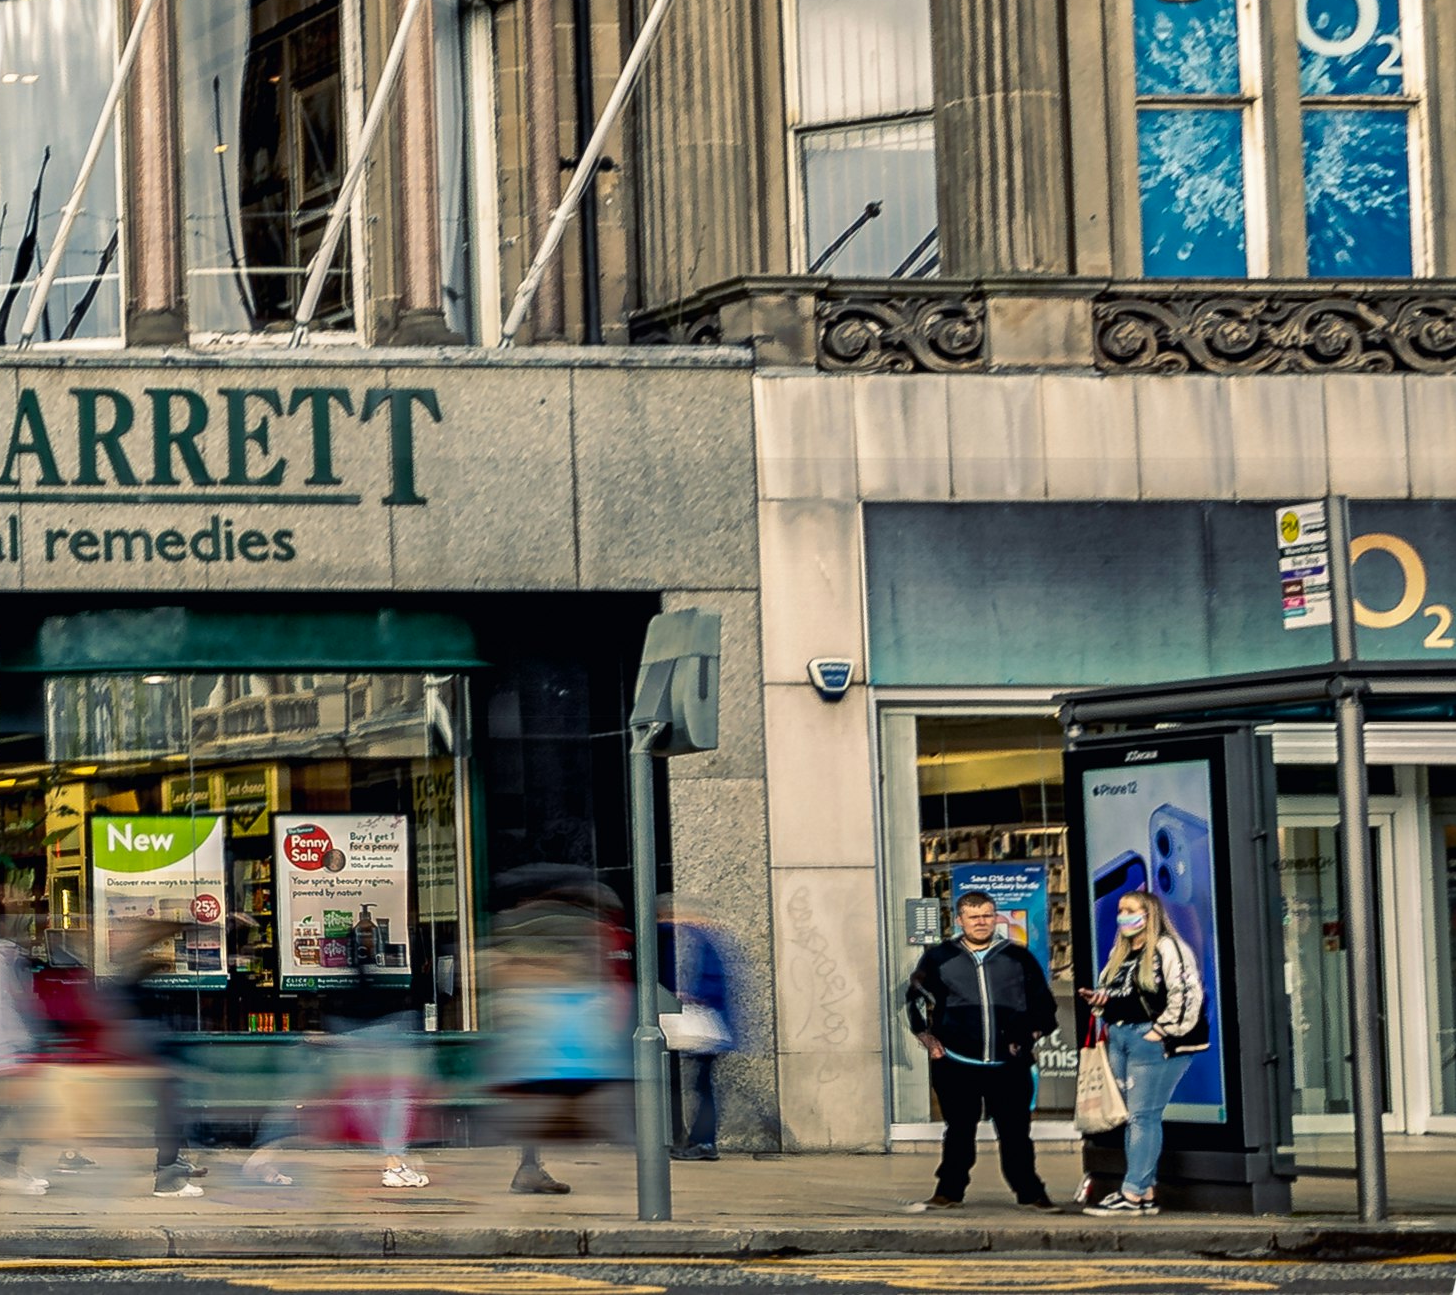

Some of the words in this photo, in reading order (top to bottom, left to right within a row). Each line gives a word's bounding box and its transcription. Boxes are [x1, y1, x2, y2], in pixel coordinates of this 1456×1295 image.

[45, 515, 297, 563] remedies
[107, 822, 174, 853] New
[350, 832, 367, 843] Buy
[369, 832, 373, 840] 1
[375, 833, 390, 843] get
[391, 832, 395, 840] 1
[291, 835, 330, 856] Penny
[350, 842, 363, 850] for
[291, 849, 319, 862] Sale
[107, 877, 139, 887] Discover
[158, 879, 178, 888] ways
[179, 878, 188, 886] to
[189, 877, 222, 886] wellness
[291, 876, 310, 885] Your
[311, 877, 335, 887] spring
[336, 877, 363, 887] beauty
[959, 883, 990, 891] Samsung
[991, 882, 1014, 891] Galaxy
[292, 890, 324, 898] powered
[325, 889, 335, 898] by
[205, 909, 218, 919] off
